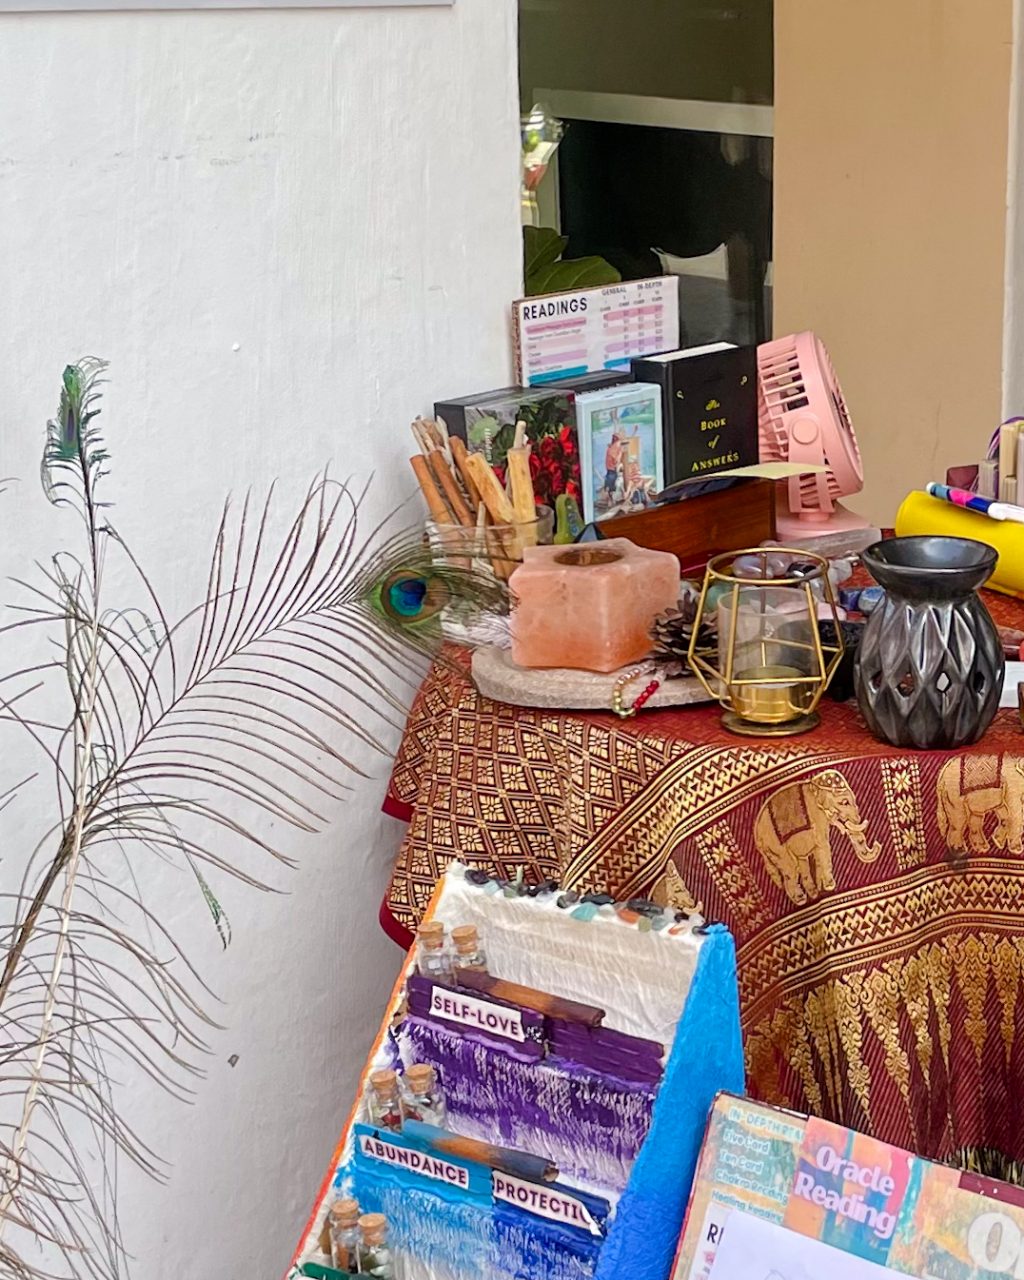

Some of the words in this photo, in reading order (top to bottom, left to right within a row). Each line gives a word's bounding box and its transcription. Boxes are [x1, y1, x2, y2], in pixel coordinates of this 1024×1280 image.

[523, 297, 588, 320] READINGS
[691, 451, 740, 472] ANSWERS
[433, 995, 519, 1036] SELF-LOVE
[364, 1138, 468, 1185] ABUNDANCE
[744, 1135, 771, 1155] Card
[816, 1145, 896, 1196] Oracle
[794, 1171, 897, 1240] Reading
